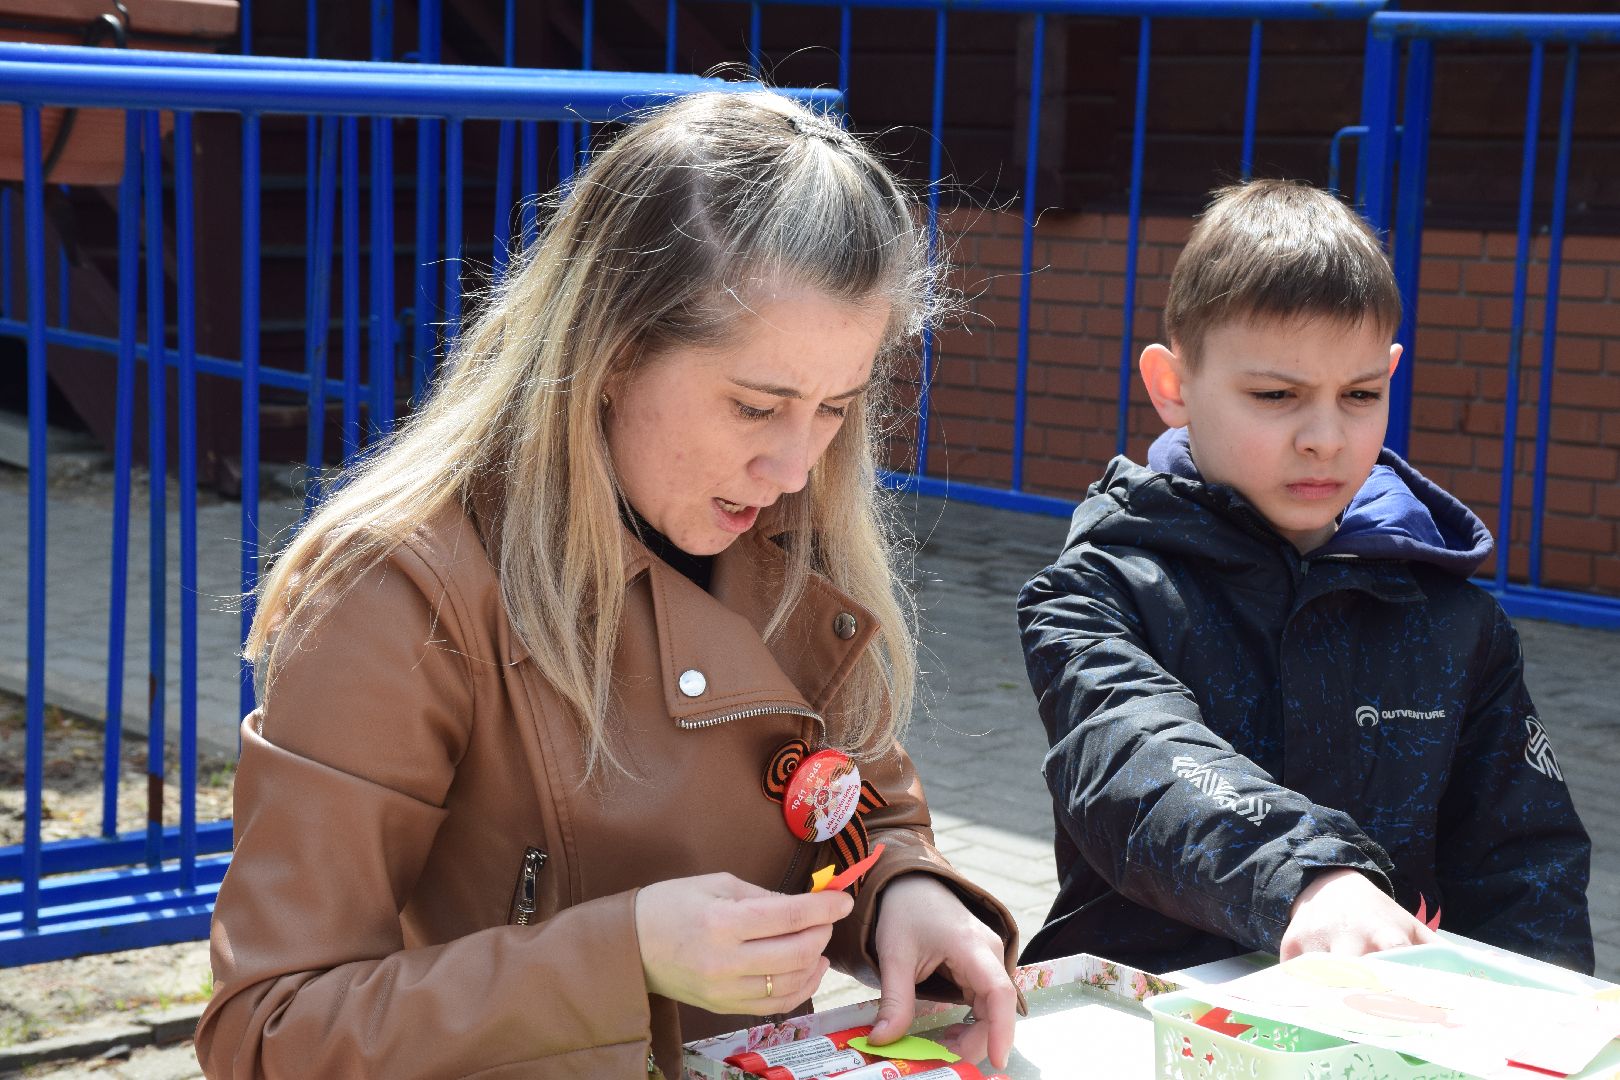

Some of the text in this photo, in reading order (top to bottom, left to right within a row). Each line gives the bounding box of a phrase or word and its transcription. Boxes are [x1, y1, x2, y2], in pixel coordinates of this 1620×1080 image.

[1381, 709, 1446, 720] OUTVENTURE
[791, 762, 822, 811] 1941 1945
[825, 817, 835, 830] МЫ
[829, 822, 839, 835] МЫ
